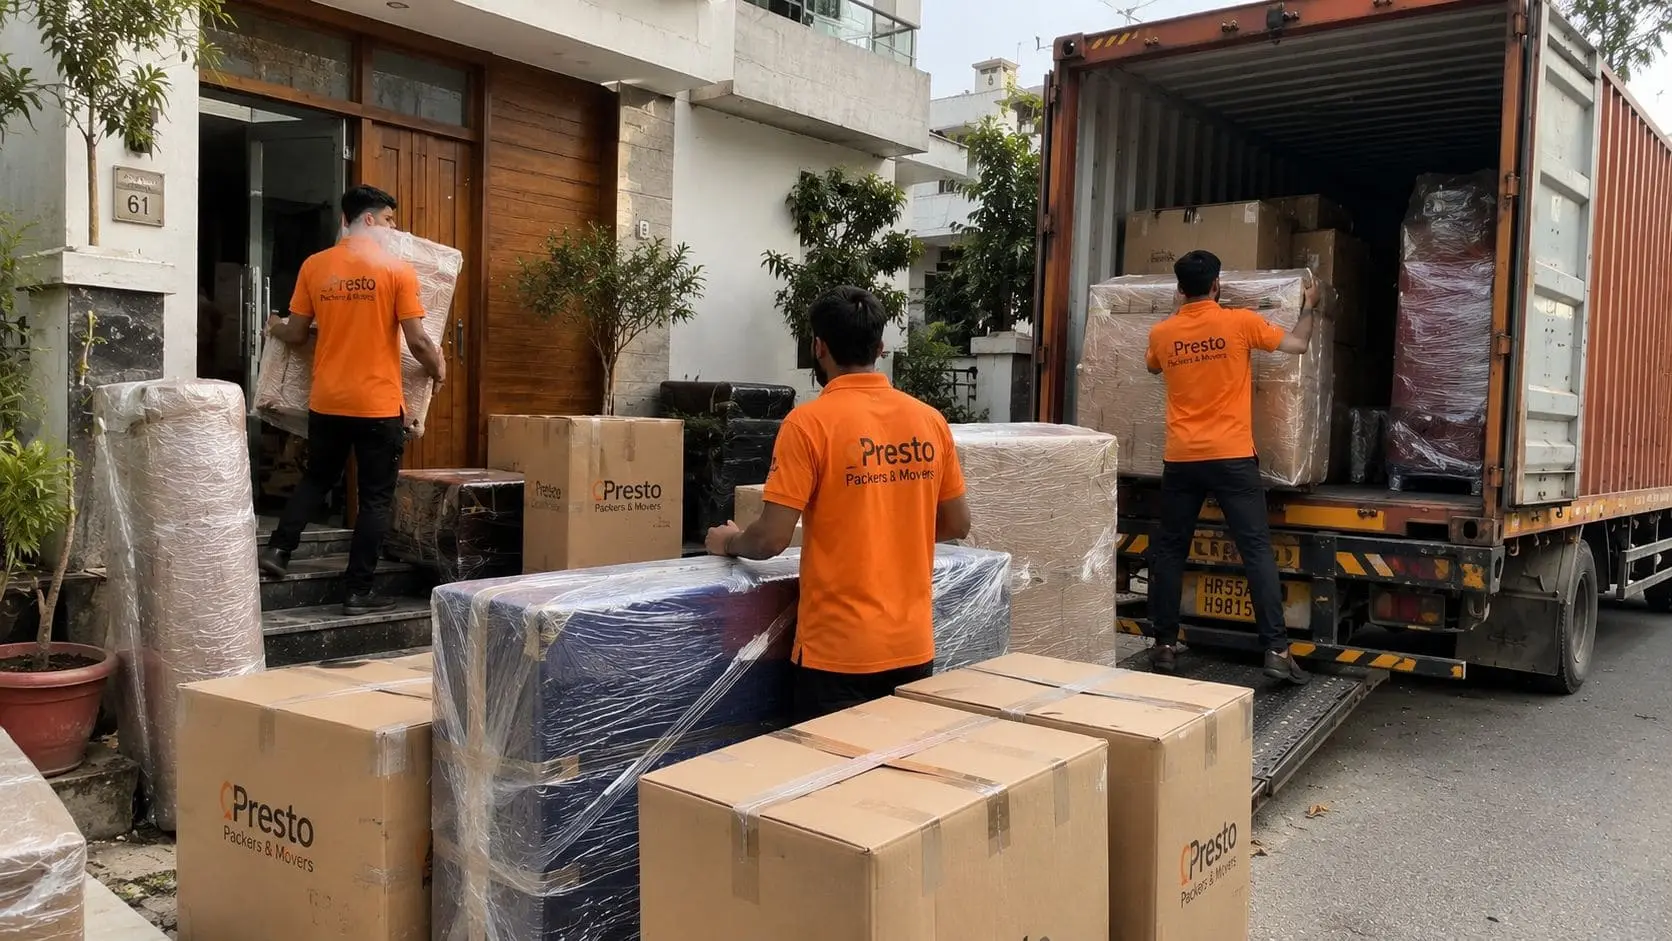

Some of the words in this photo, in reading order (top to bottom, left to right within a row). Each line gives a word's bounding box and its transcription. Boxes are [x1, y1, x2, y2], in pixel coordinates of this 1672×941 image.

[128, 195, 148, 215] 61
[1174, 336, 1226, 356] Presto
[860, 436, 935, 467] Presto
[845, 472, 888, 487] Packers
[890, 470, 897, 482] &
[899, 468, 935, 481] Movers
[603, 480, 662, 500] Presto
[595, 503, 626, 513] Packers
[627, 502, 633, 511] &
[634, 502, 662, 512] Movers
[1204, 597, 1253, 617] H9815
[233, 784, 314, 848] Presto
[223, 825, 263, 853] Packers
[264, 840, 273, 857] &
[275, 844, 314, 873] Movers
[1189, 820, 1238, 881] Presto
